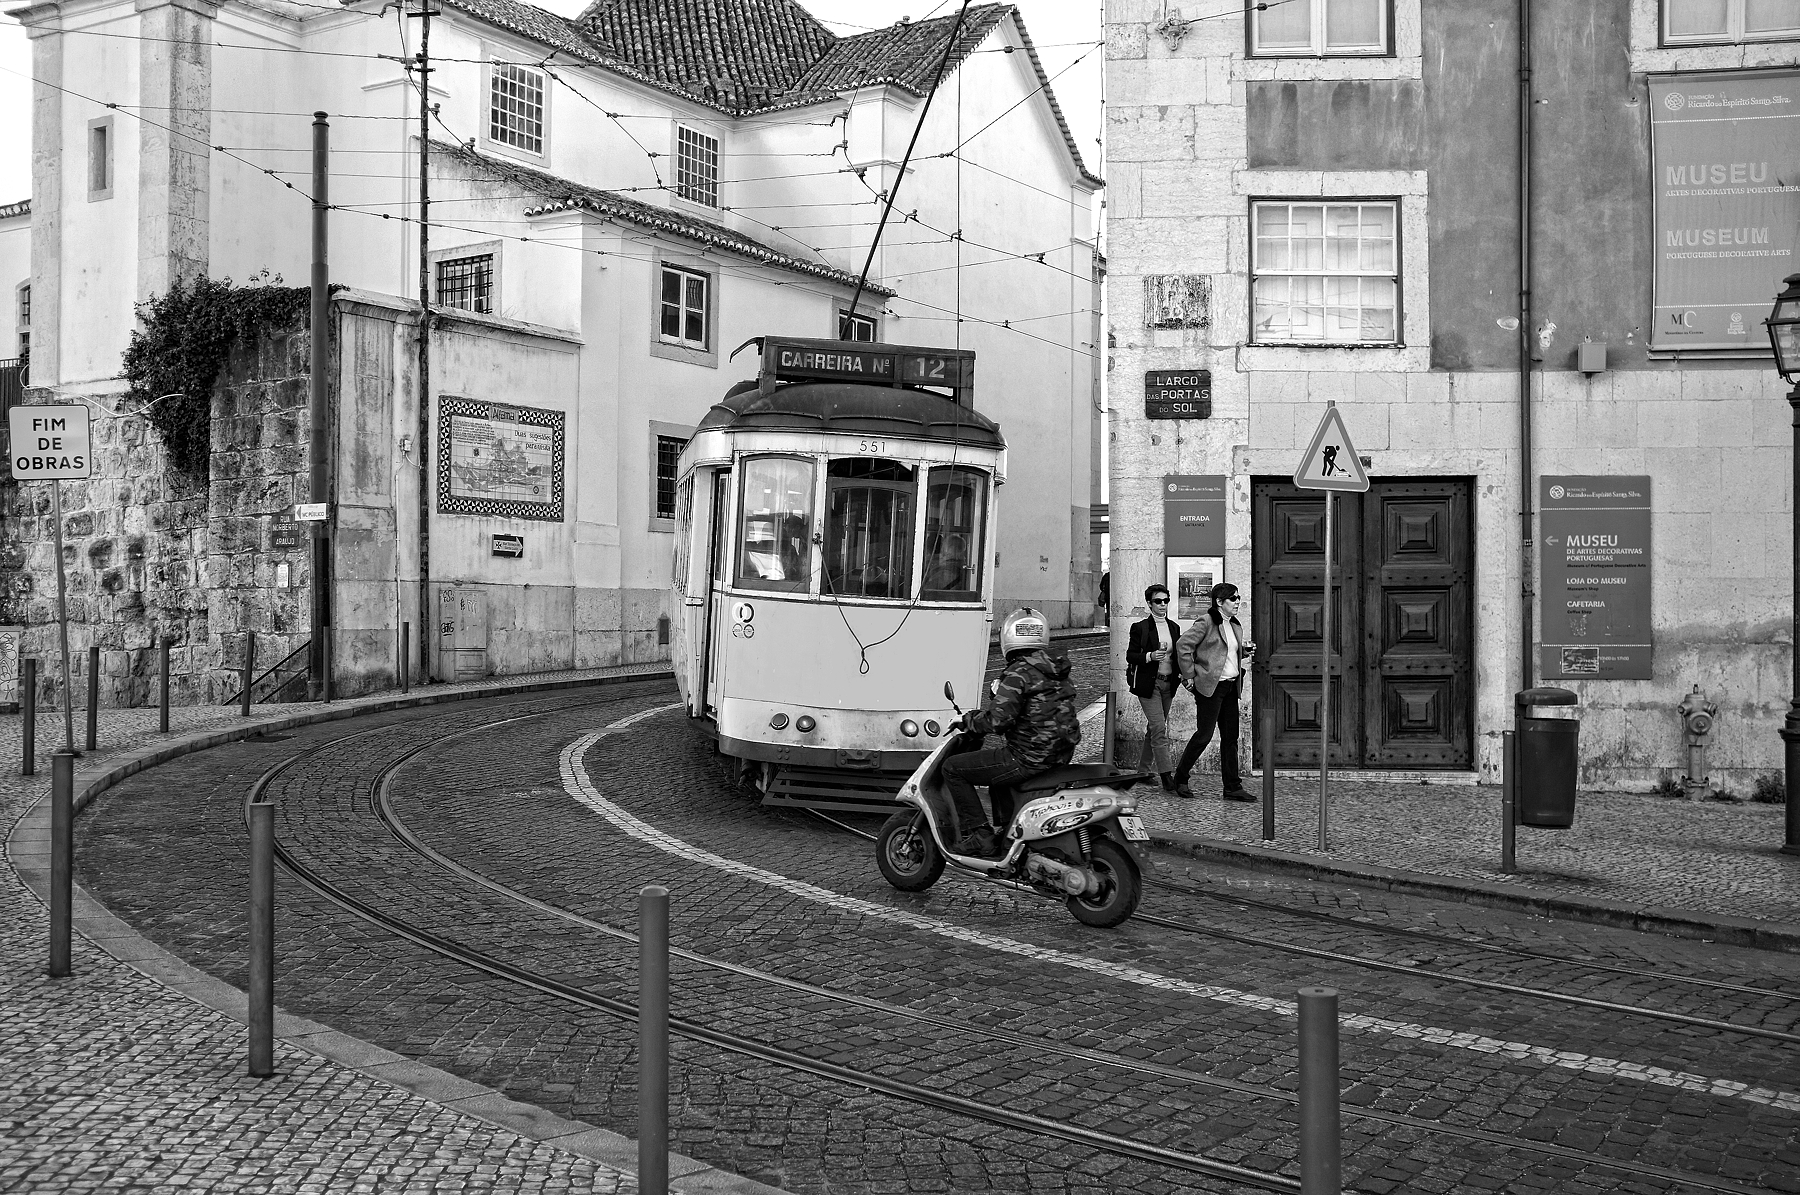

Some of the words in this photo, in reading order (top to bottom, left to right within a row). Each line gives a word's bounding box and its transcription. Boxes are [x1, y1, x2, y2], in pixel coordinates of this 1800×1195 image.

[1688, 99, 1714, 108] Ricardo
[1723, 98, 1750, 108] Espírito
[1666, 162, 1768, 186] MUSEU
[1691, 188, 1745, 196] DECORATIVAS
[1666, 227, 1769, 247] MUSEUM
[1666, 252, 1718, 260] PORTUGUESE
[1719, 250, 1770, 258] DECORATIVE
[781, 350, 863, 373] CARREIRA
[916, 357, 945, 379] 12
[1156, 376, 1198, 386] LARGO
[1161, 389, 1209, 399] PORTAS
[1173, 403, 1198, 412] SOL
[492, 408, 515, 421] Alfama
[32, 418, 66, 431] FIM
[38, 437, 63, 450] DE
[859, 440, 885, 453] 551
[16, 456, 84, 470] OBRAS
[279, 515, 290, 523] RUA
[272, 523, 298, 532] NORBERTO
[1566, 535, 1618, 547] MUSEU
[1566, 577, 1585, 585] LOJA
[1586, 577, 1599, 585] DO
[1600, 577, 1627, 585] MUSEU
[1566, 600, 1606, 608] CAFETARIA
[1127, 818, 1136, 828] 91
